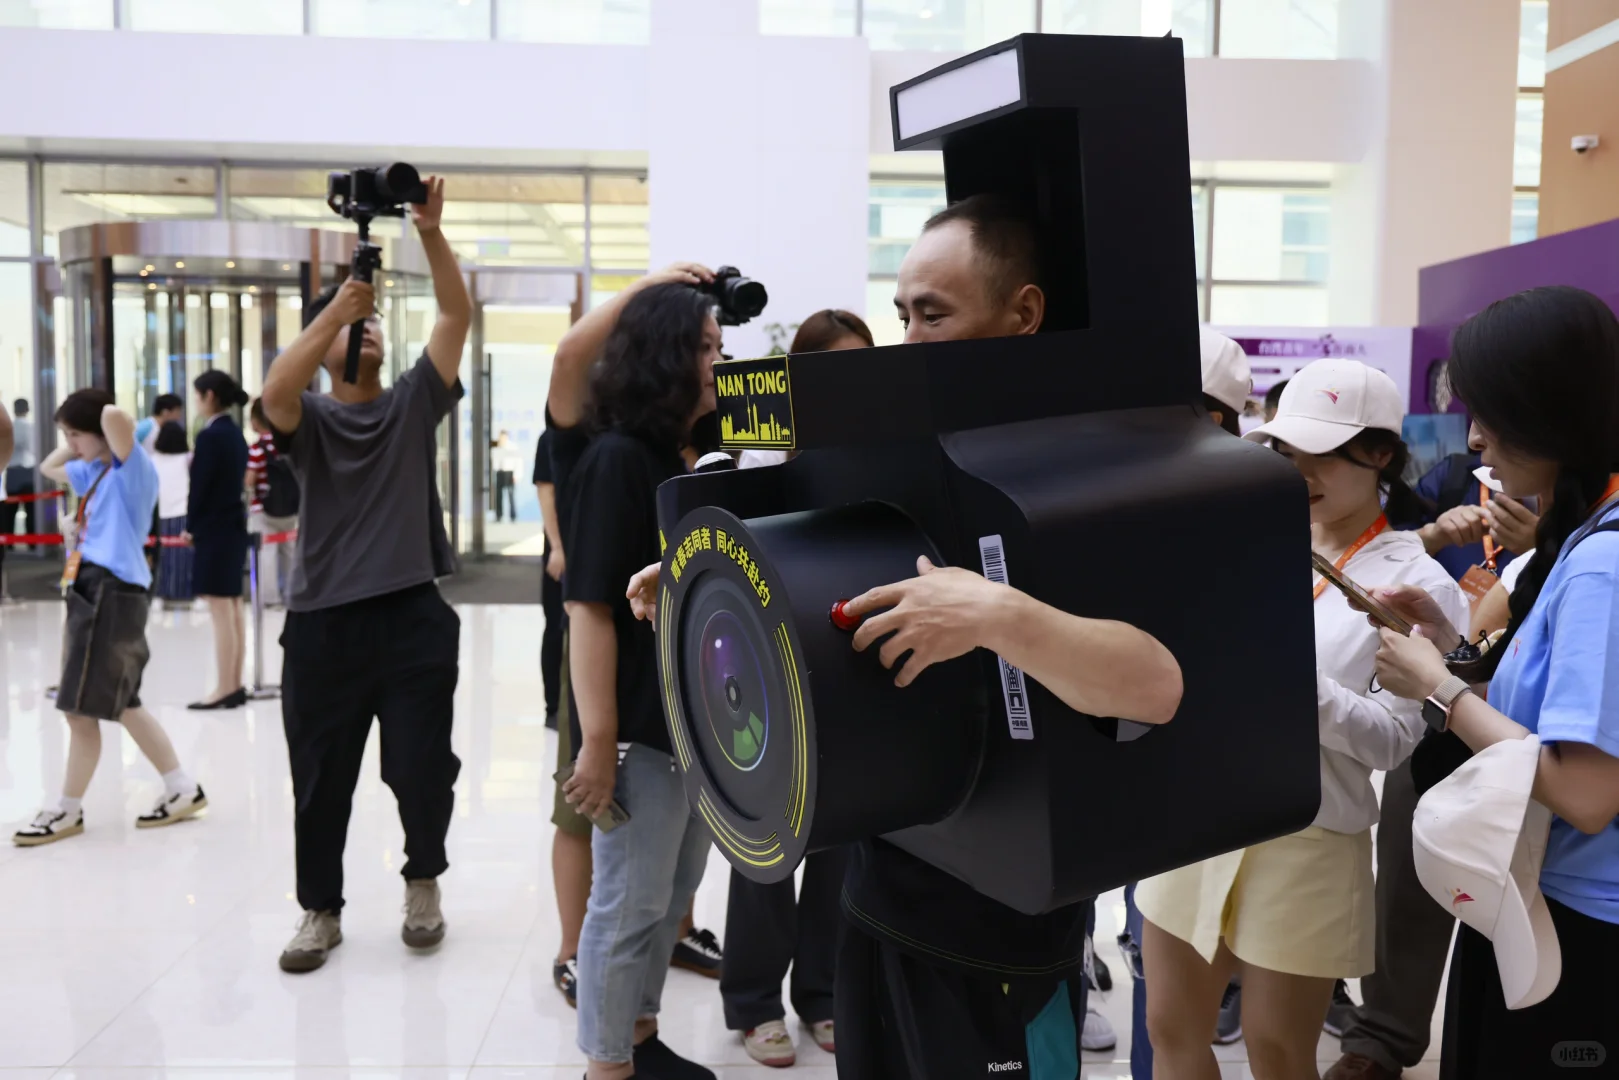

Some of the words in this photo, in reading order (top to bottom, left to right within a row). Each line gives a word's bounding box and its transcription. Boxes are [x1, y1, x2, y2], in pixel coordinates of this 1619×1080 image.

[717, 373, 744, 397] NAN
[746, 370, 787, 395] TONG
[716, 529, 771, 608] 同心共赴约
[987, 1060, 1023, 1073] Kinetics
